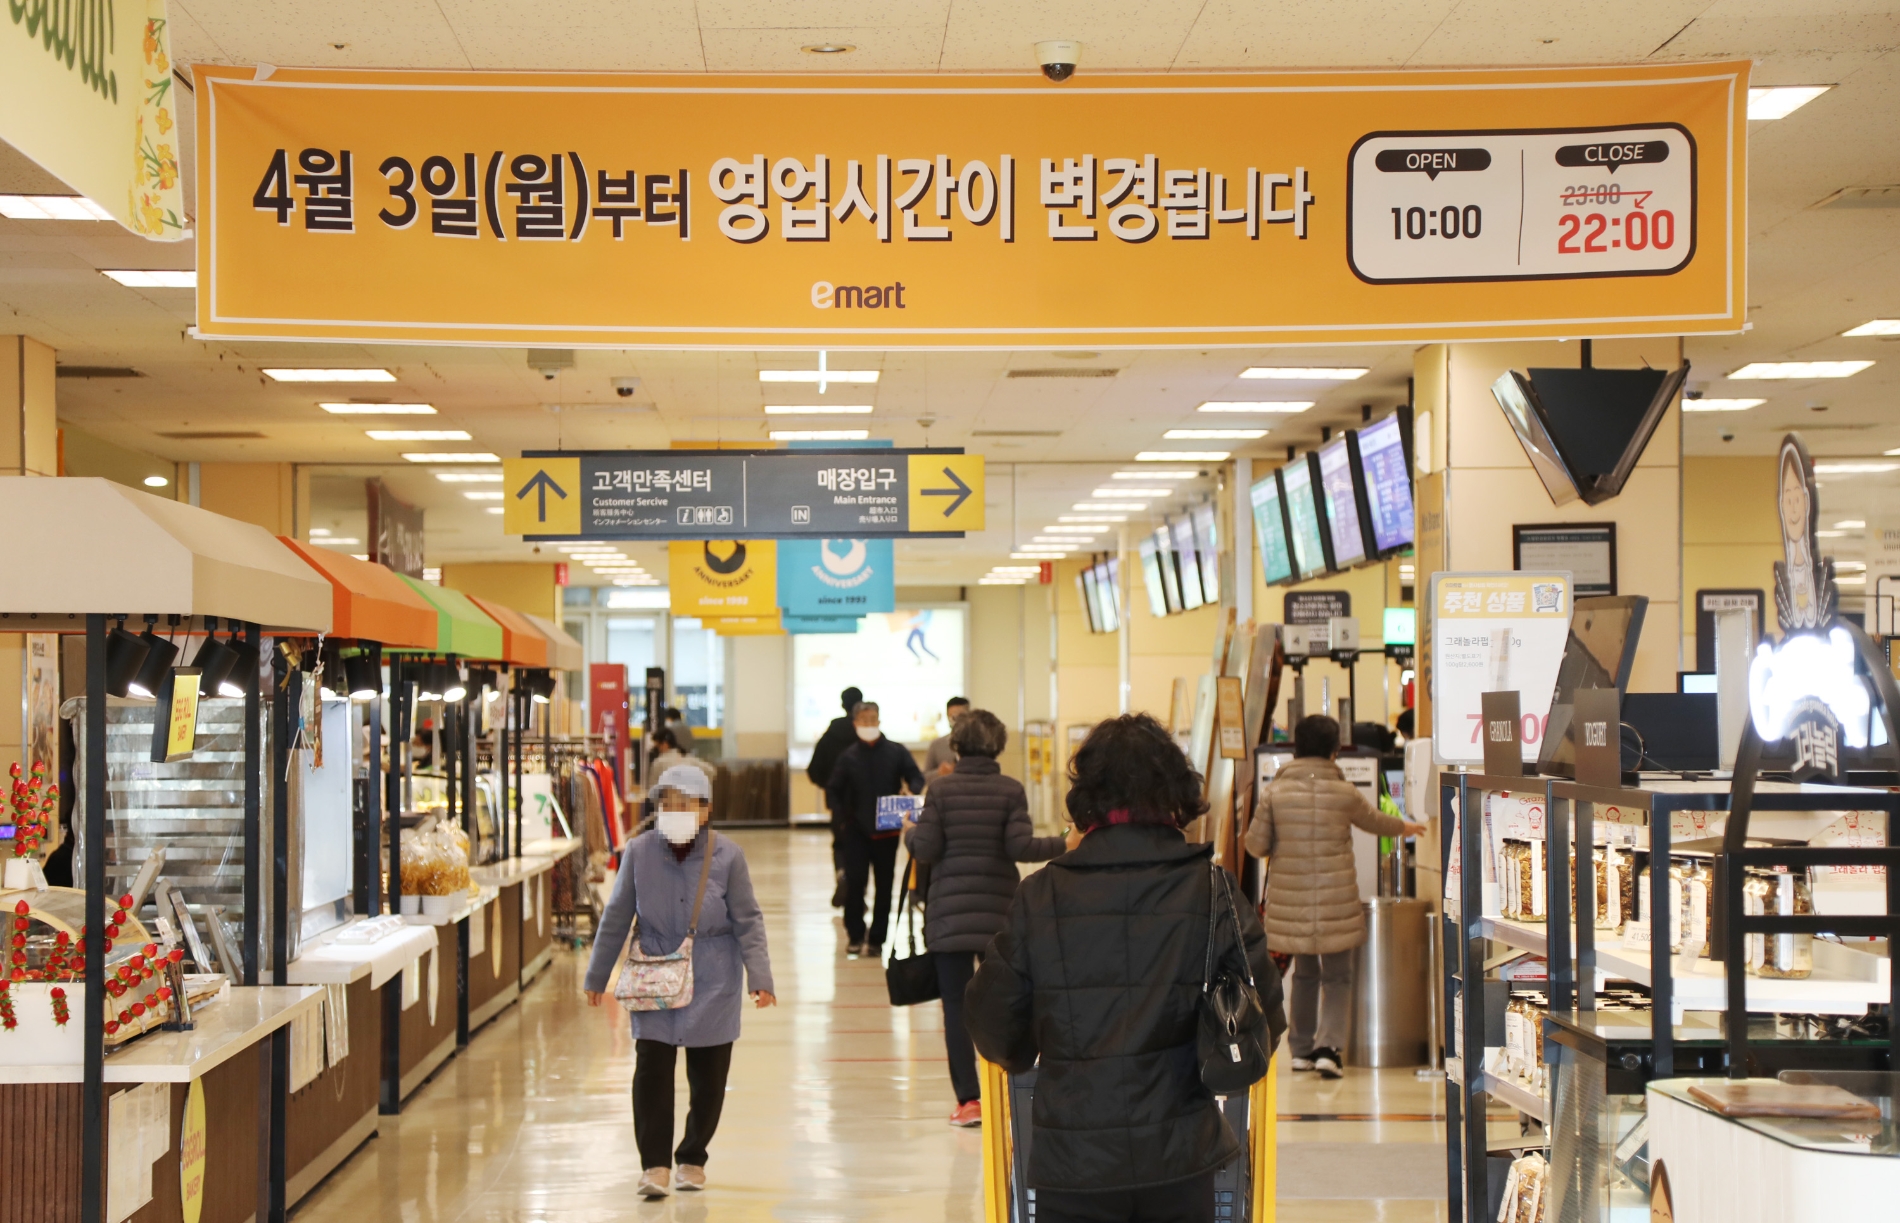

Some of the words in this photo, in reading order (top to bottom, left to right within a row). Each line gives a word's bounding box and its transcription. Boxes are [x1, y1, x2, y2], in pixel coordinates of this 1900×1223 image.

[1405, 152, 1457, 169] OPEN
[1584, 143, 1644, 164] CLOSE
[253, 147, 355, 234] 4월
[380, 150, 690, 242] 3일(월)부터
[709, 154, 1015, 243] 영업시간이
[1040, 154, 1315, 243] 변경됩니다
[1563, 182, 1622, 207] 23:00
[1391, 204, 1482, 240] 10:00
[1557, 209, 1675, 255] 22:00
[811, 281, 906, 309] emart
[592, 469, 712, 493] 고객만족센터
[817, 467, 898, 491] 매장입구
[593, 497, 634, 507] Customer
[636, 496, 668, 507] Sercive
[833, 495, 857, 505] Main
[858, 495, 897, 505] Entrance
[793, 509, 808, 521] IN
[693, 565, 755, 589] ANNIVERSARY
[811, 564, 875, 589] ANNIVERSARY
[1443, 591, 1483, 614] 추천
[1487, 591, 1526, 613] 상품
[1489, 720, 1513, 742] GRANOLA
[1584, 721, 1607, 747] YOGURT
